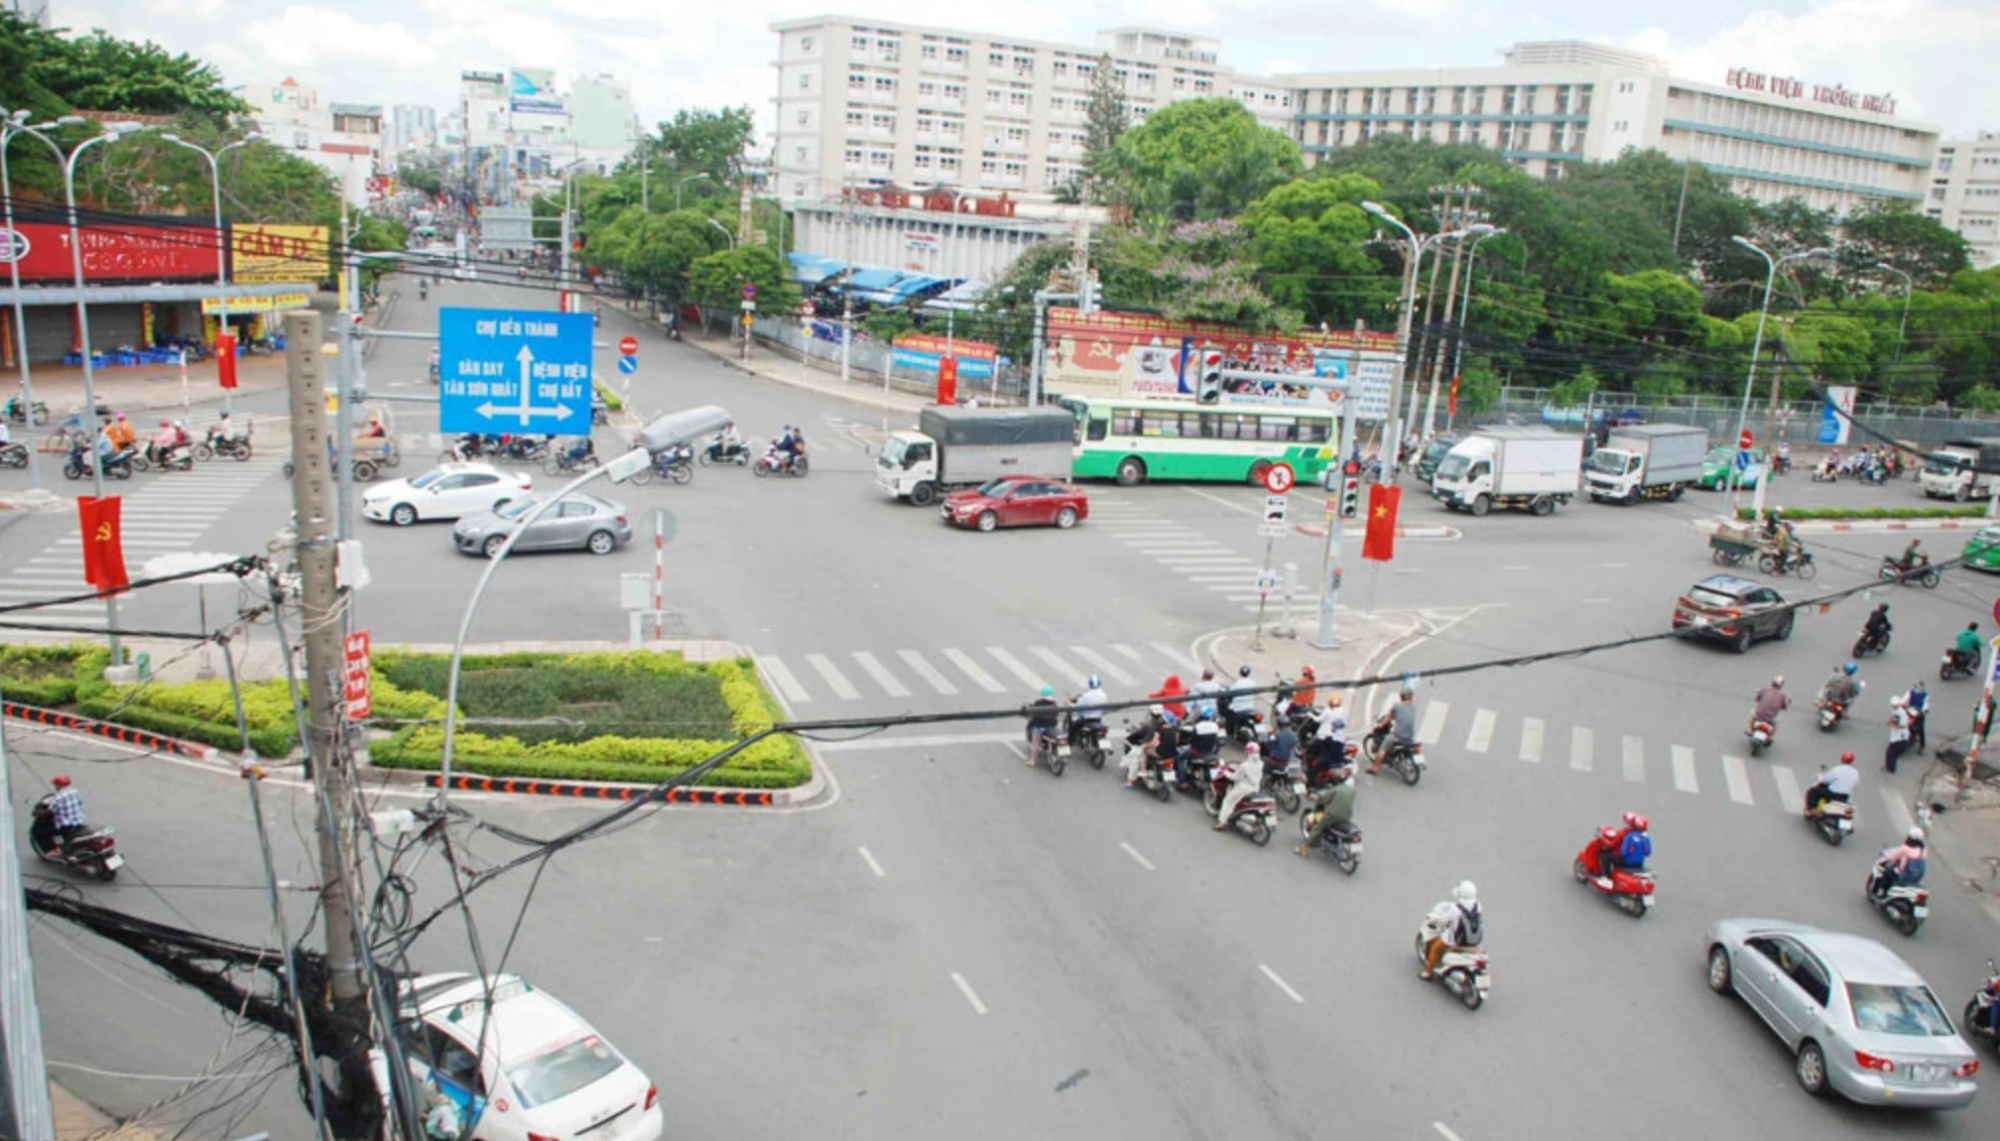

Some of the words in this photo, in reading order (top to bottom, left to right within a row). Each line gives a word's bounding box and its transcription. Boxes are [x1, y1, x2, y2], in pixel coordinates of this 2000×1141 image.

[476, 320, 497, 337] CHỢ
[458, 359, 480, 375] SÂN
[444, 379, 464, 395] TÂN
